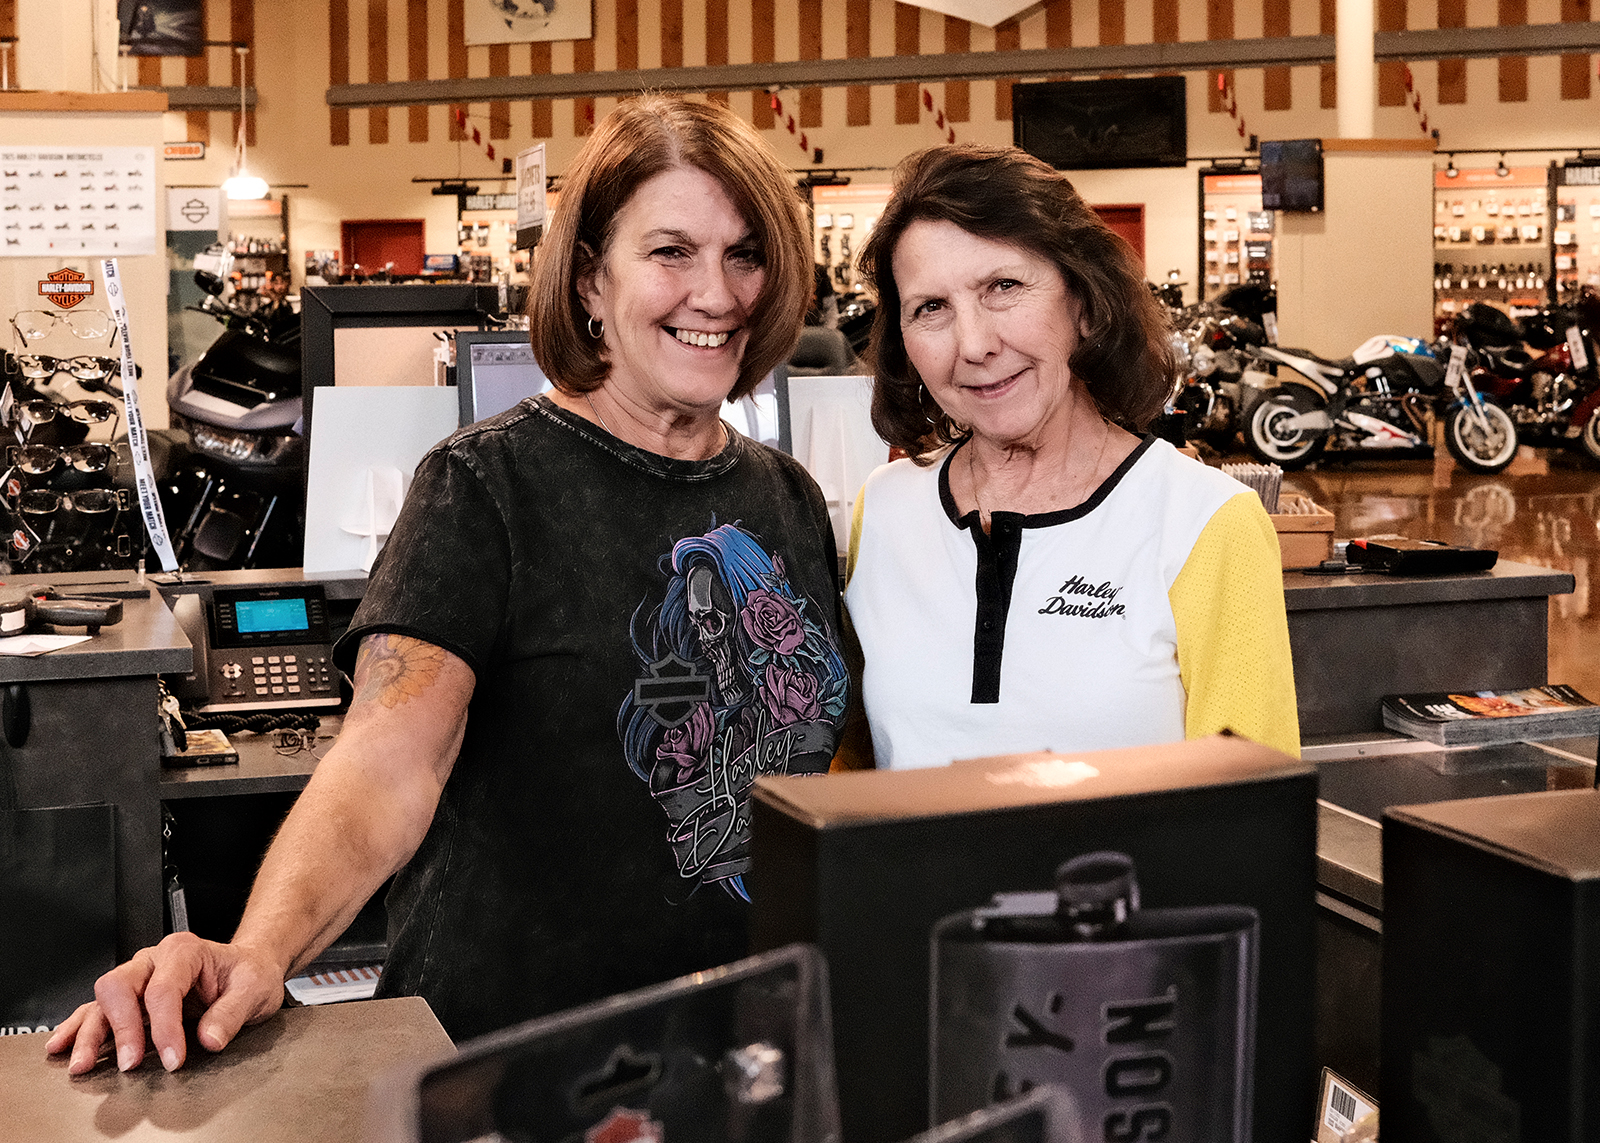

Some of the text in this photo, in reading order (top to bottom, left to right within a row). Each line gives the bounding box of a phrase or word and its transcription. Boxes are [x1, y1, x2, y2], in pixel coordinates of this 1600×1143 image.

[52, 272, 80, 281] MOTOR
[41, 283, 91, 293] HARLEY-DAVIDSON
[52, 294, 80, 306] CYCLES
[138, 477, 149, 495] MEET
[141, 494, 153, 511] YOUR
[145, 510, 158, 531] MATCH
